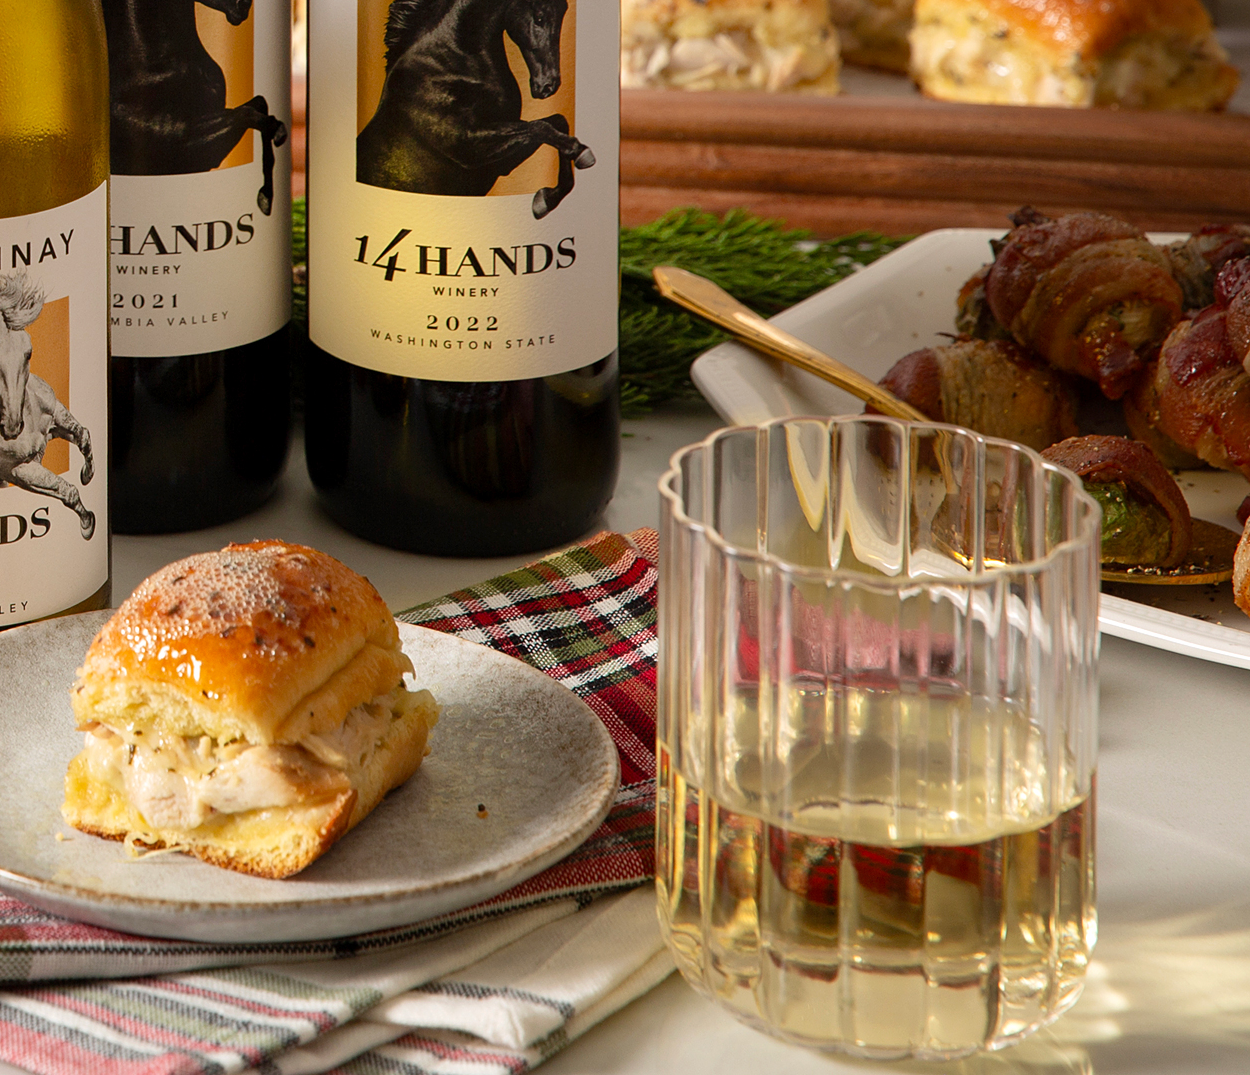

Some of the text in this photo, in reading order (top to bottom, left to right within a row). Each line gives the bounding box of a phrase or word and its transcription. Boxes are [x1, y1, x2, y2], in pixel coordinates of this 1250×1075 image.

[110, 212, 255, 256] HANDS
[354, 228, 577, 282] 14 HANDS
[116, 264, 181, 275] WINERY
[432, 286, 500, 298] WINERY
[112, 293, 178, 309] 2021
[111, 310, 229, 327] MBIA VALLEY
[426, 314, 499, 332] 2022
[370, 328, 556, 350] WASHINGTON STATE
